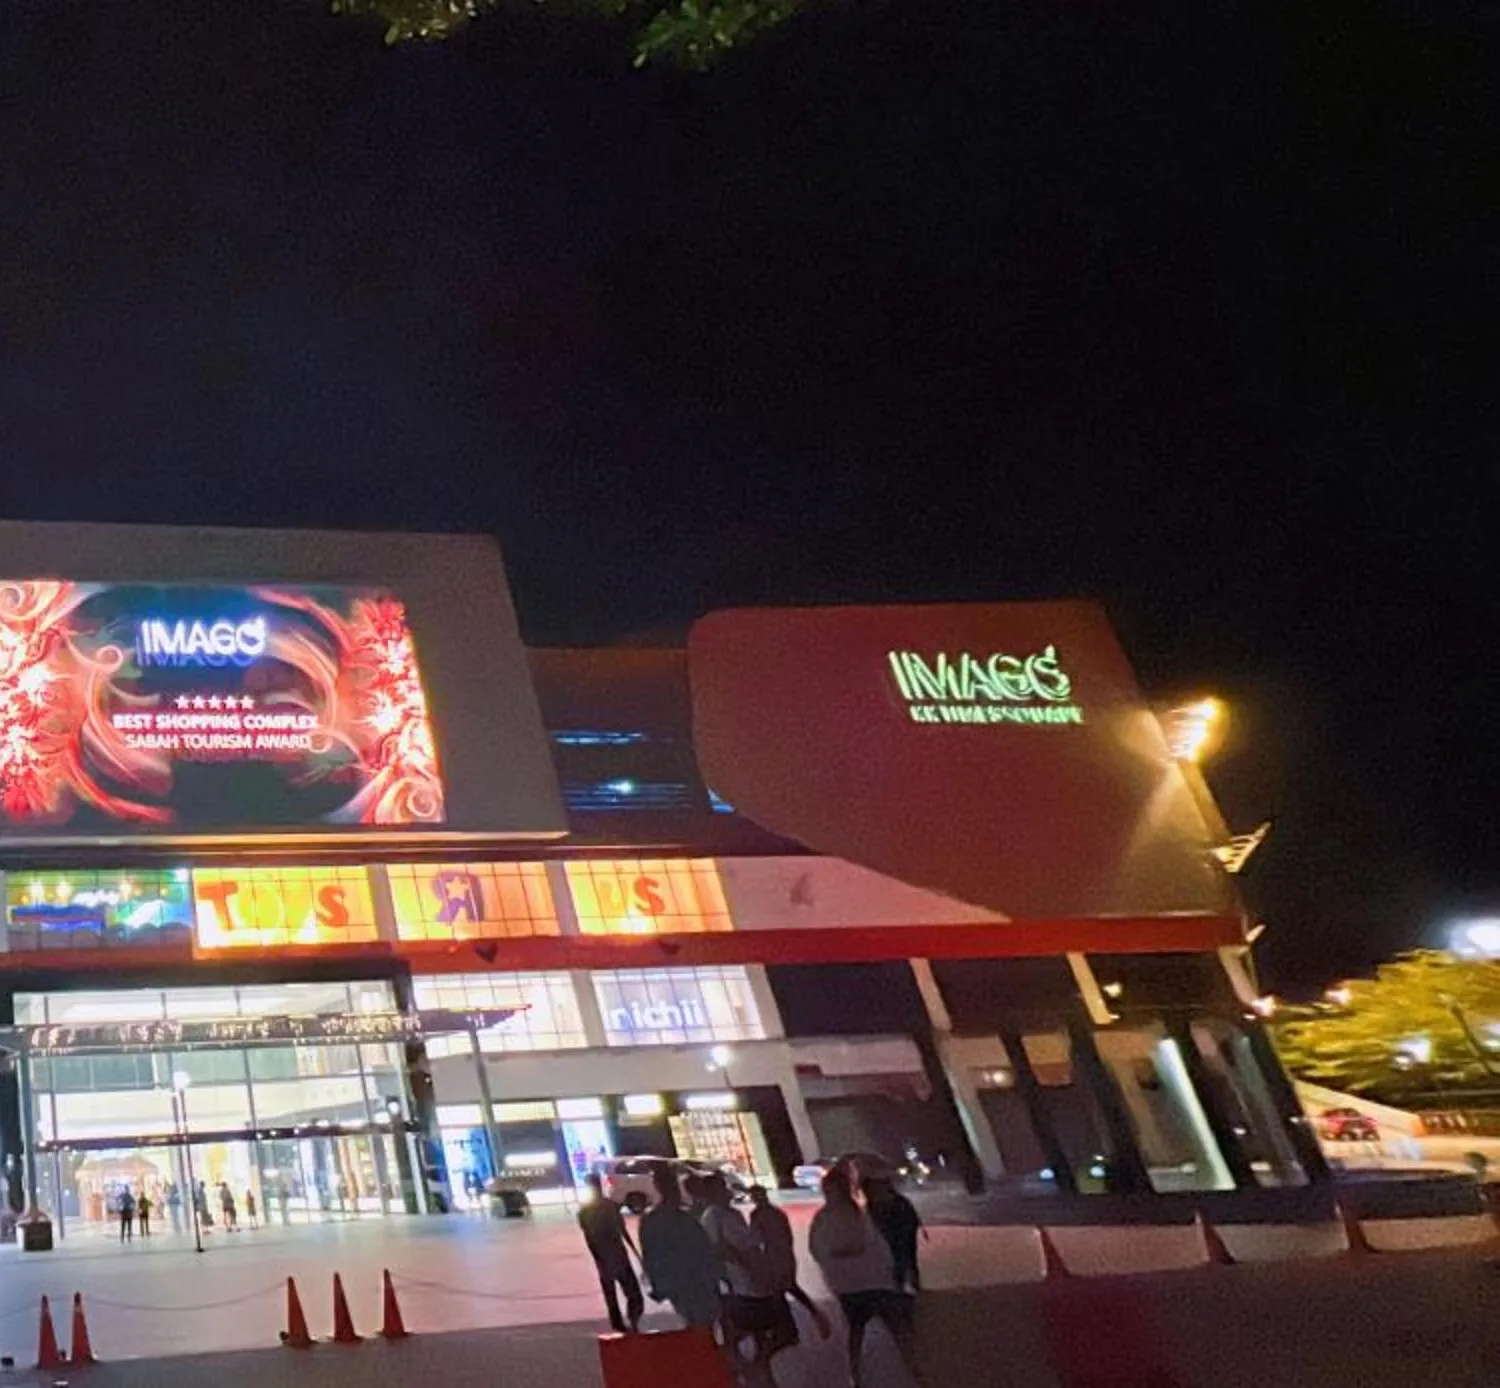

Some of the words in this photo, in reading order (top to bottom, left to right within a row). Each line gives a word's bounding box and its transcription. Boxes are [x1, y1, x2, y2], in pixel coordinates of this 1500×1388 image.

[141, 615, 266, 656] IMAGO
[888, 645, 1071, 700] IMAGO
[113, 714, 153, 729] BEST
[156, 714, 241, 729] SHOPPING
[244, 715, 319, 729] COMPLEX
[125, 734, 179, 749] SABAH
[184, 734, 252, 749] TOURISM
[255, 734, 313, 748] AWARD
